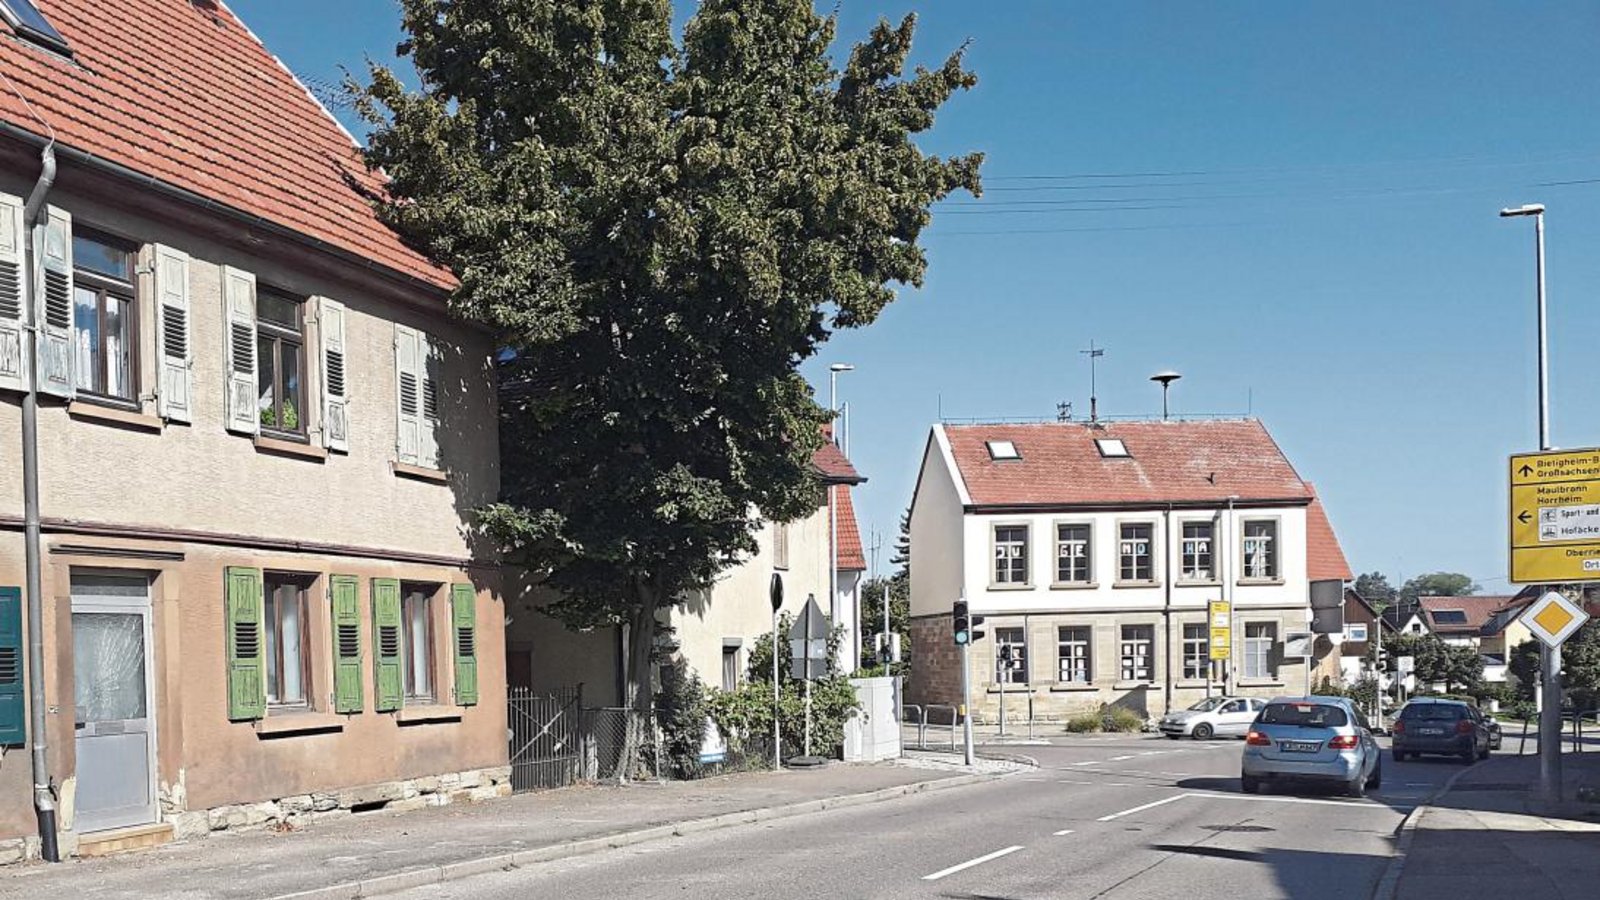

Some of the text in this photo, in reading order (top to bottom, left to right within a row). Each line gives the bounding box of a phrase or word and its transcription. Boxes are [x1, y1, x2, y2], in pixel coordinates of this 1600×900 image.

[1537, 456, 1599, 467] Bietigheim-B
[1537, 486, 1587, 494] Maulbronn
[1537, 496, 1582, 504] Horrheim
